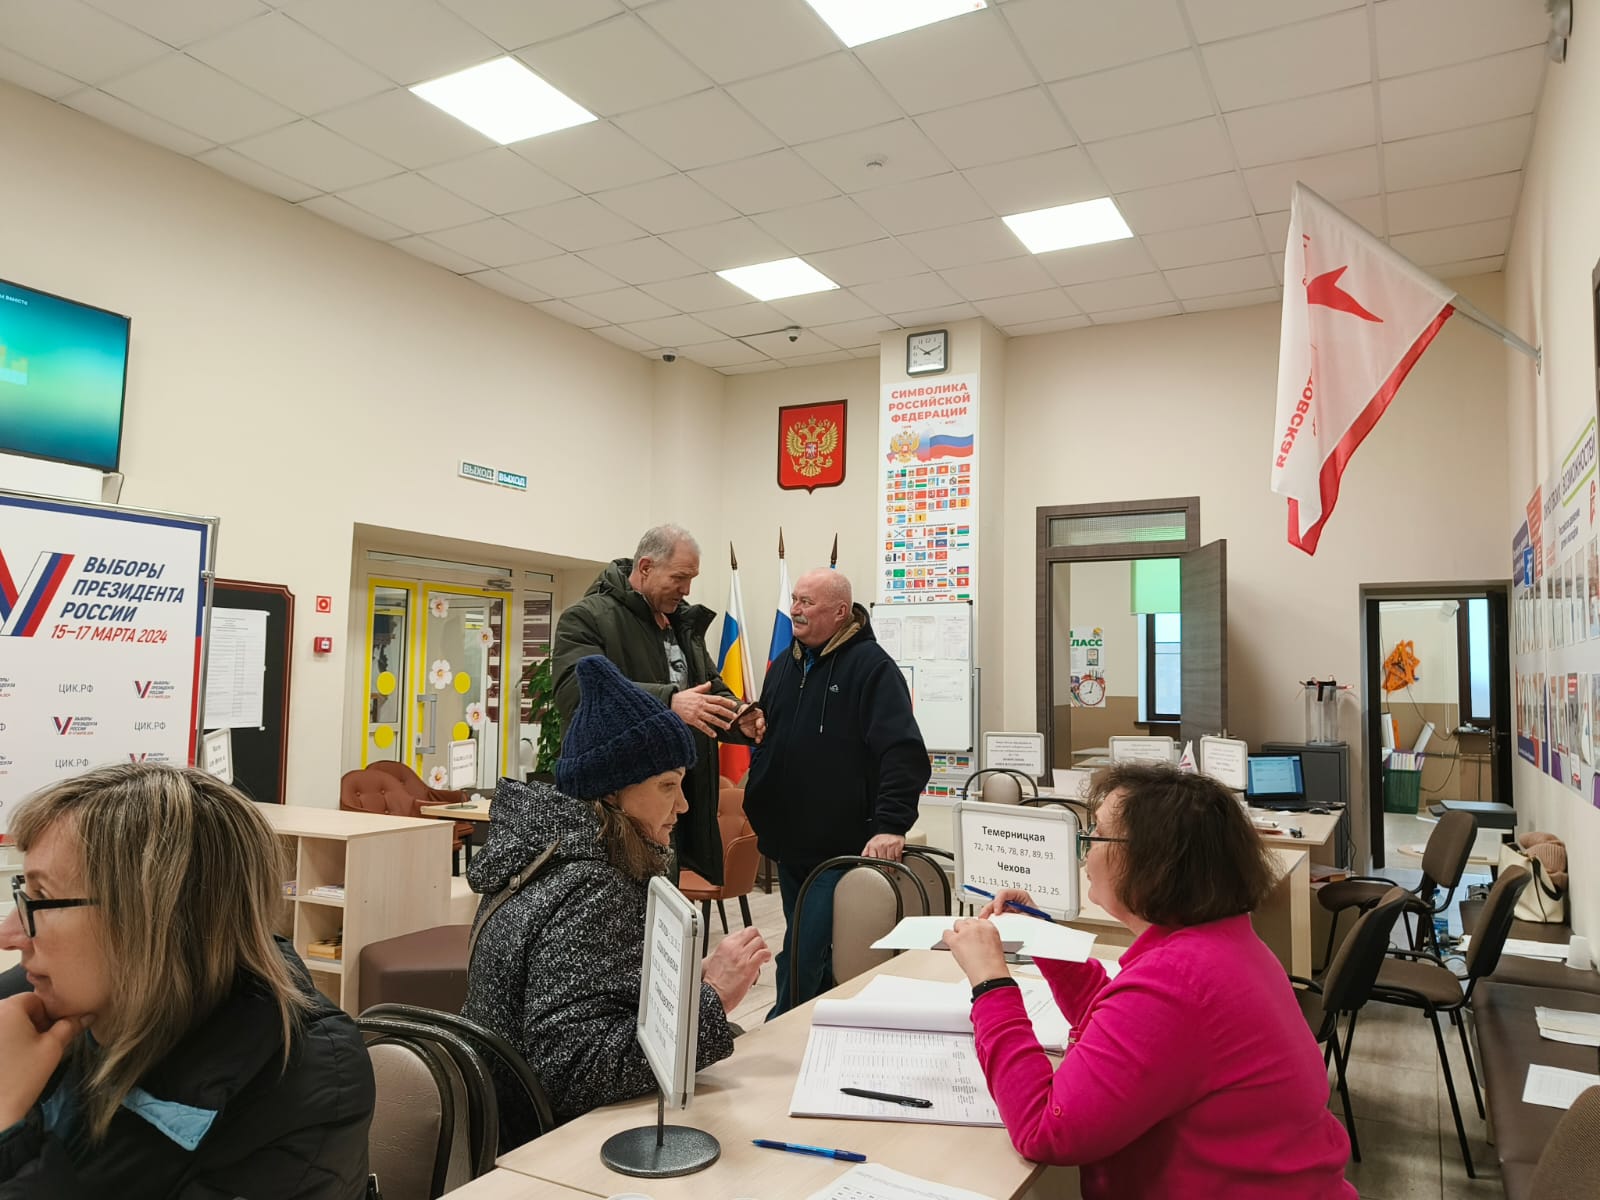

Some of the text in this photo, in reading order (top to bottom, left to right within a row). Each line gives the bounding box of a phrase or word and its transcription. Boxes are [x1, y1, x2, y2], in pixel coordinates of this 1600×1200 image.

[891, 382, 968, 399] СИМВОЛИКА
[888, 392, 970, 412] РОССИЙСКОЙ
[891, 407, 967, 422] ФЕДЕРАЦИИ
[464, 464, 525, 486] ВЫХОД ВЫХОД
[83, 556, 165, 579] ВЫБОРЫ
[72, 579, 184, 604] ПРЕЗИДЕНТА
[60, 602, 138, 622] РОССИИ
[91, 626, 134, 642] МАРТА
[137, 629, 168, 644] 2024
[58, 684, 94, 694] ЦИК.РФ
[134, 722, 166, 731] ЦИК.РФ
[55, 758, 88, 768] ЦИК.РФ
[982, 826, 1045, 842] Темерницкая
[997, 862, 1030, 874] Чехова
